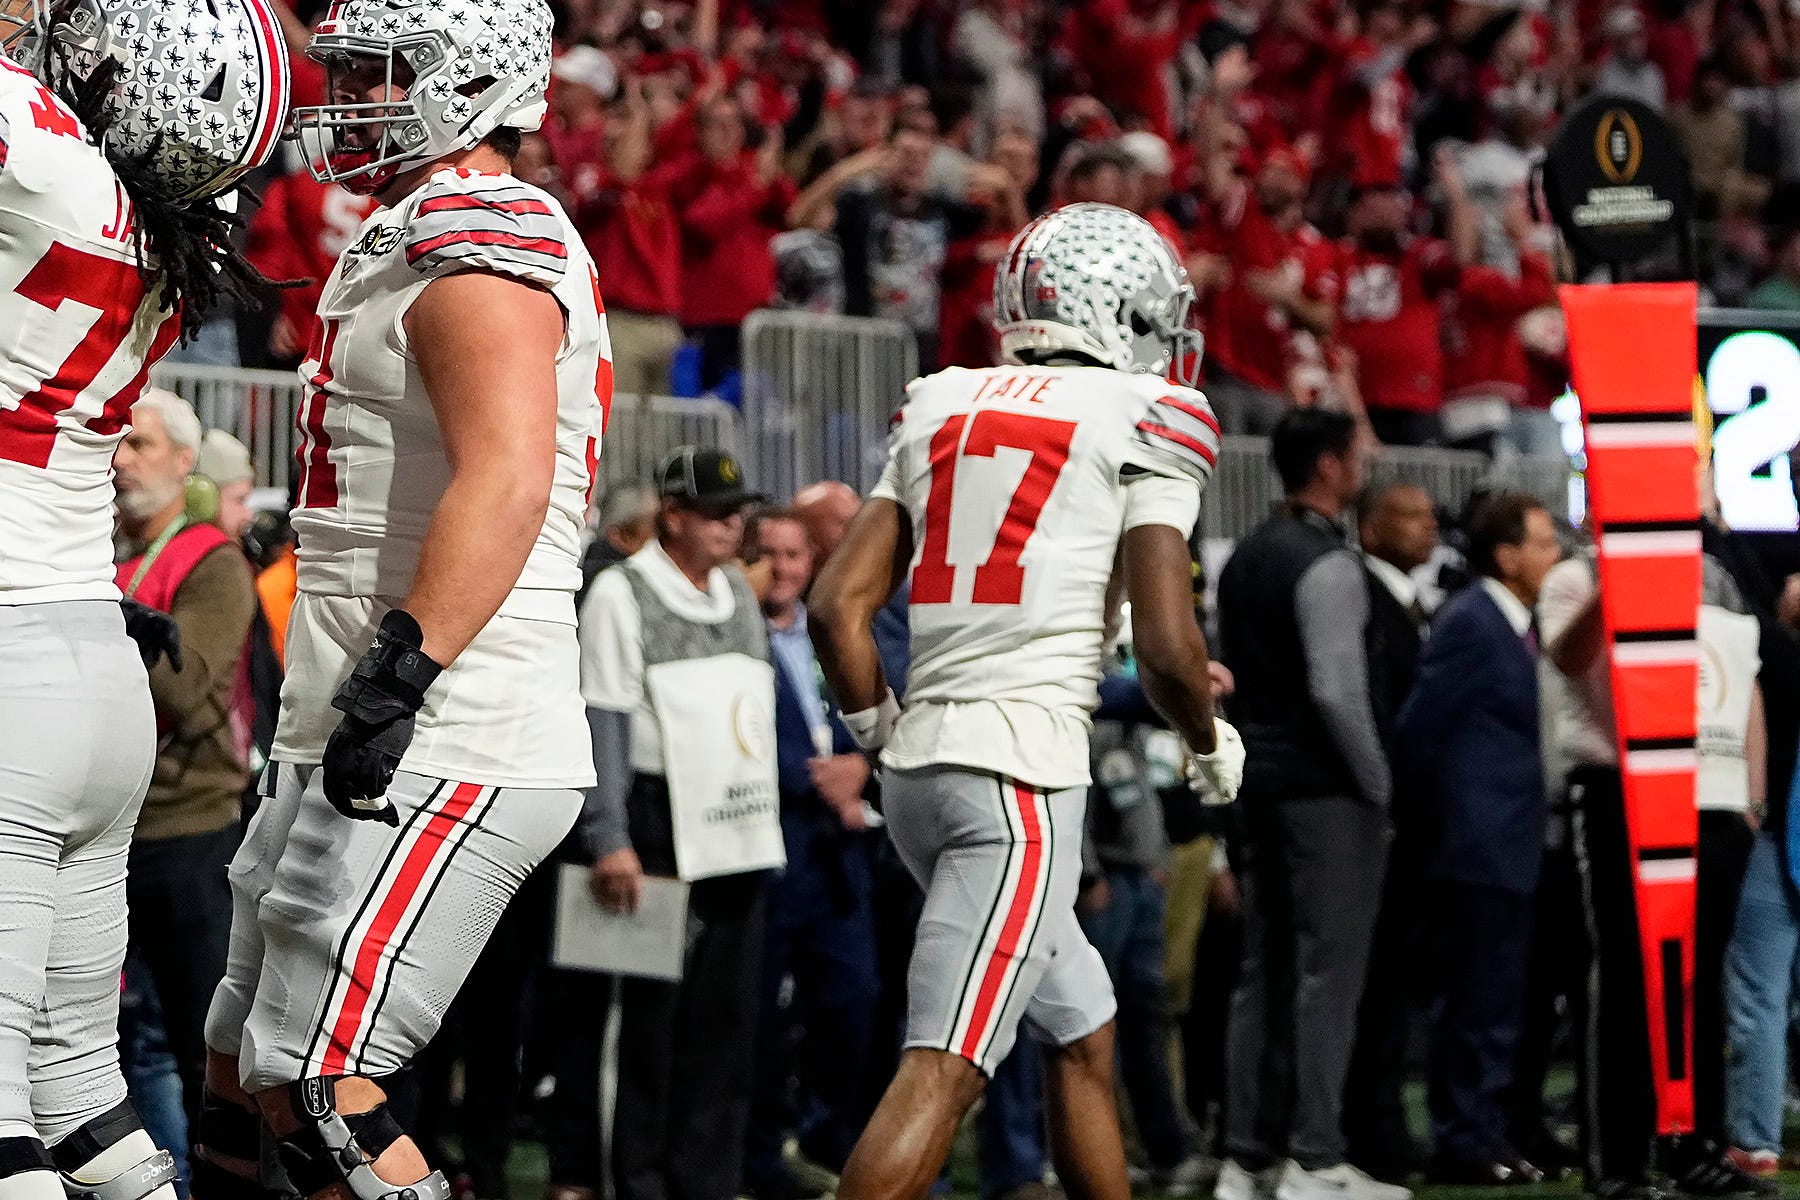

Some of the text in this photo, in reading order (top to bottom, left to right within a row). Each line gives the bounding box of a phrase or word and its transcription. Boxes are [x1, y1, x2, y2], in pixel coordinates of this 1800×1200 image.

[973, 375, 1063, 403] TATE
[1706, 330, 1800, 532] 2
[909, 408, 1078, 606] 17
